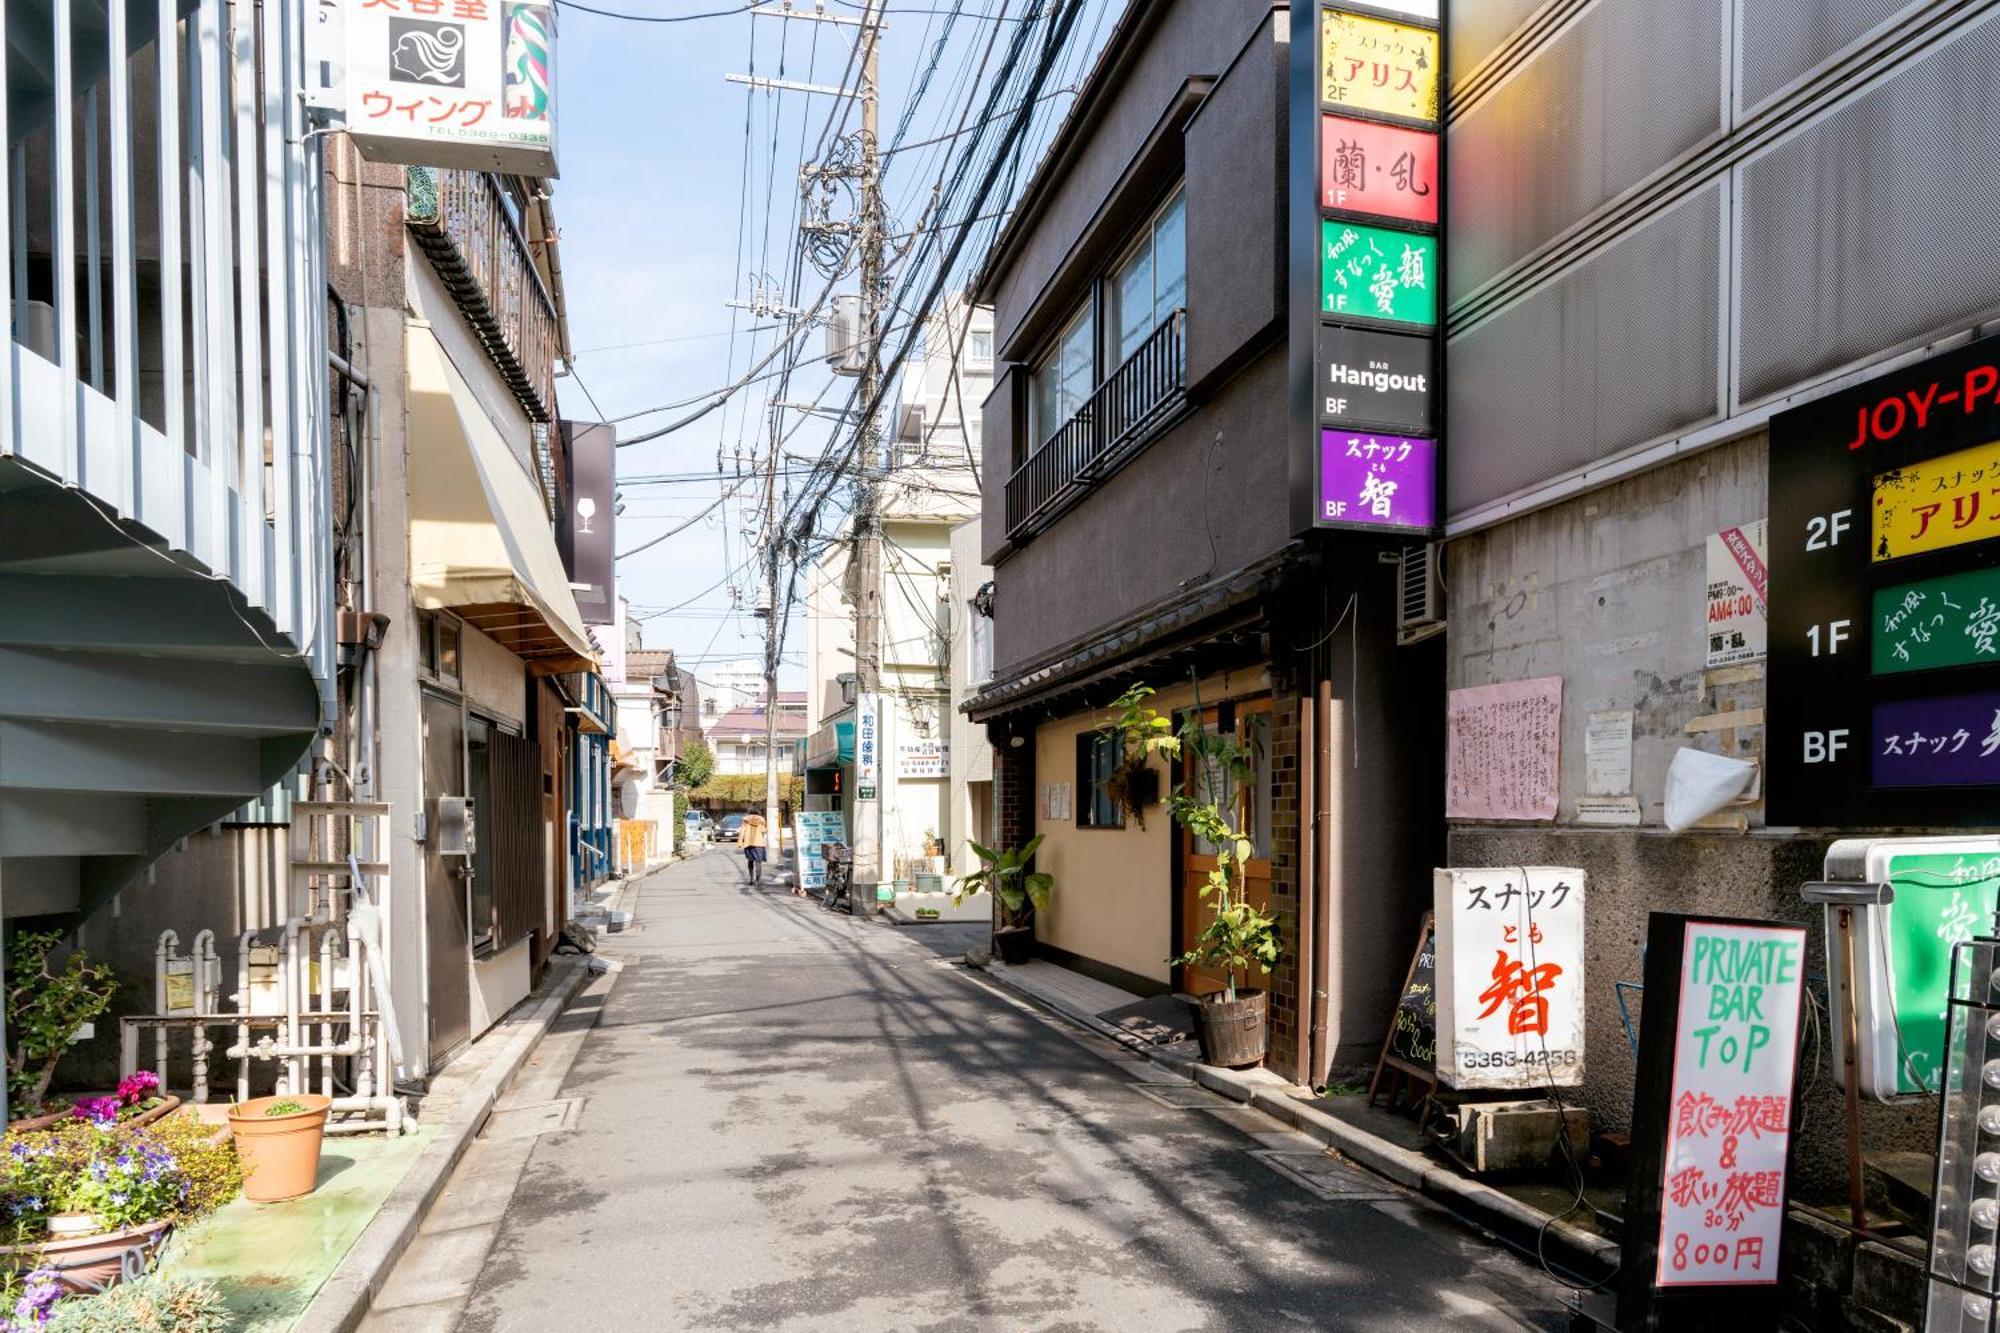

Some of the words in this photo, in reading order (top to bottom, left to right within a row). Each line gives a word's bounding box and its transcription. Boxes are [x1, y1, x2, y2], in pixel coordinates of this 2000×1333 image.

[1343, 56, 1418, 93] アリス
[362, 90, 492, 127] ウィング
[1327, 84, 1348, 101] 2F
[1333, 138, 1430, 197] 蘭・乱
[1327, 189, 1347, 205] 1F
[1327, 293, 1348, 311] 1F
[1330, 363, 1427, 393] Hangout
[1369, 360, 1389, 370] BAR
[1325, 397, 1347, 414] BF
[1848, 363, 2000, 451] JOY-P
[1345, 438, 1413, 462] スナック
[1325, 501, 1347, 517] BF
[1357, 472, 1398, 519] 智
[1806, 509, 1852, 552] 2F
[1708, 593, 1753, 623] AM4:00
[1806, 619, 1850, 657] 1F
[1803, 728, 1849, 764] BF
[1882, 728, 1970, 756] スナック
[1466, 881, 1571, 910] スナック
[1503, 921, 1544, 944] とも
[1692, 936, 1798, 985] PRIVATE
[1477, 949, 1563, 1037] 智
[1708, 984, 1764, 1023] BAR
[1677, 1090, 1789, 1140] 飲み放題
[1719, 1135, 1738, 1169] &
[1671, 1165, 1781, 1213] 歌い放題
[1704, 1208, 1745, 1232] 30分
[1672, 1232, 1763, 1271] 800円
